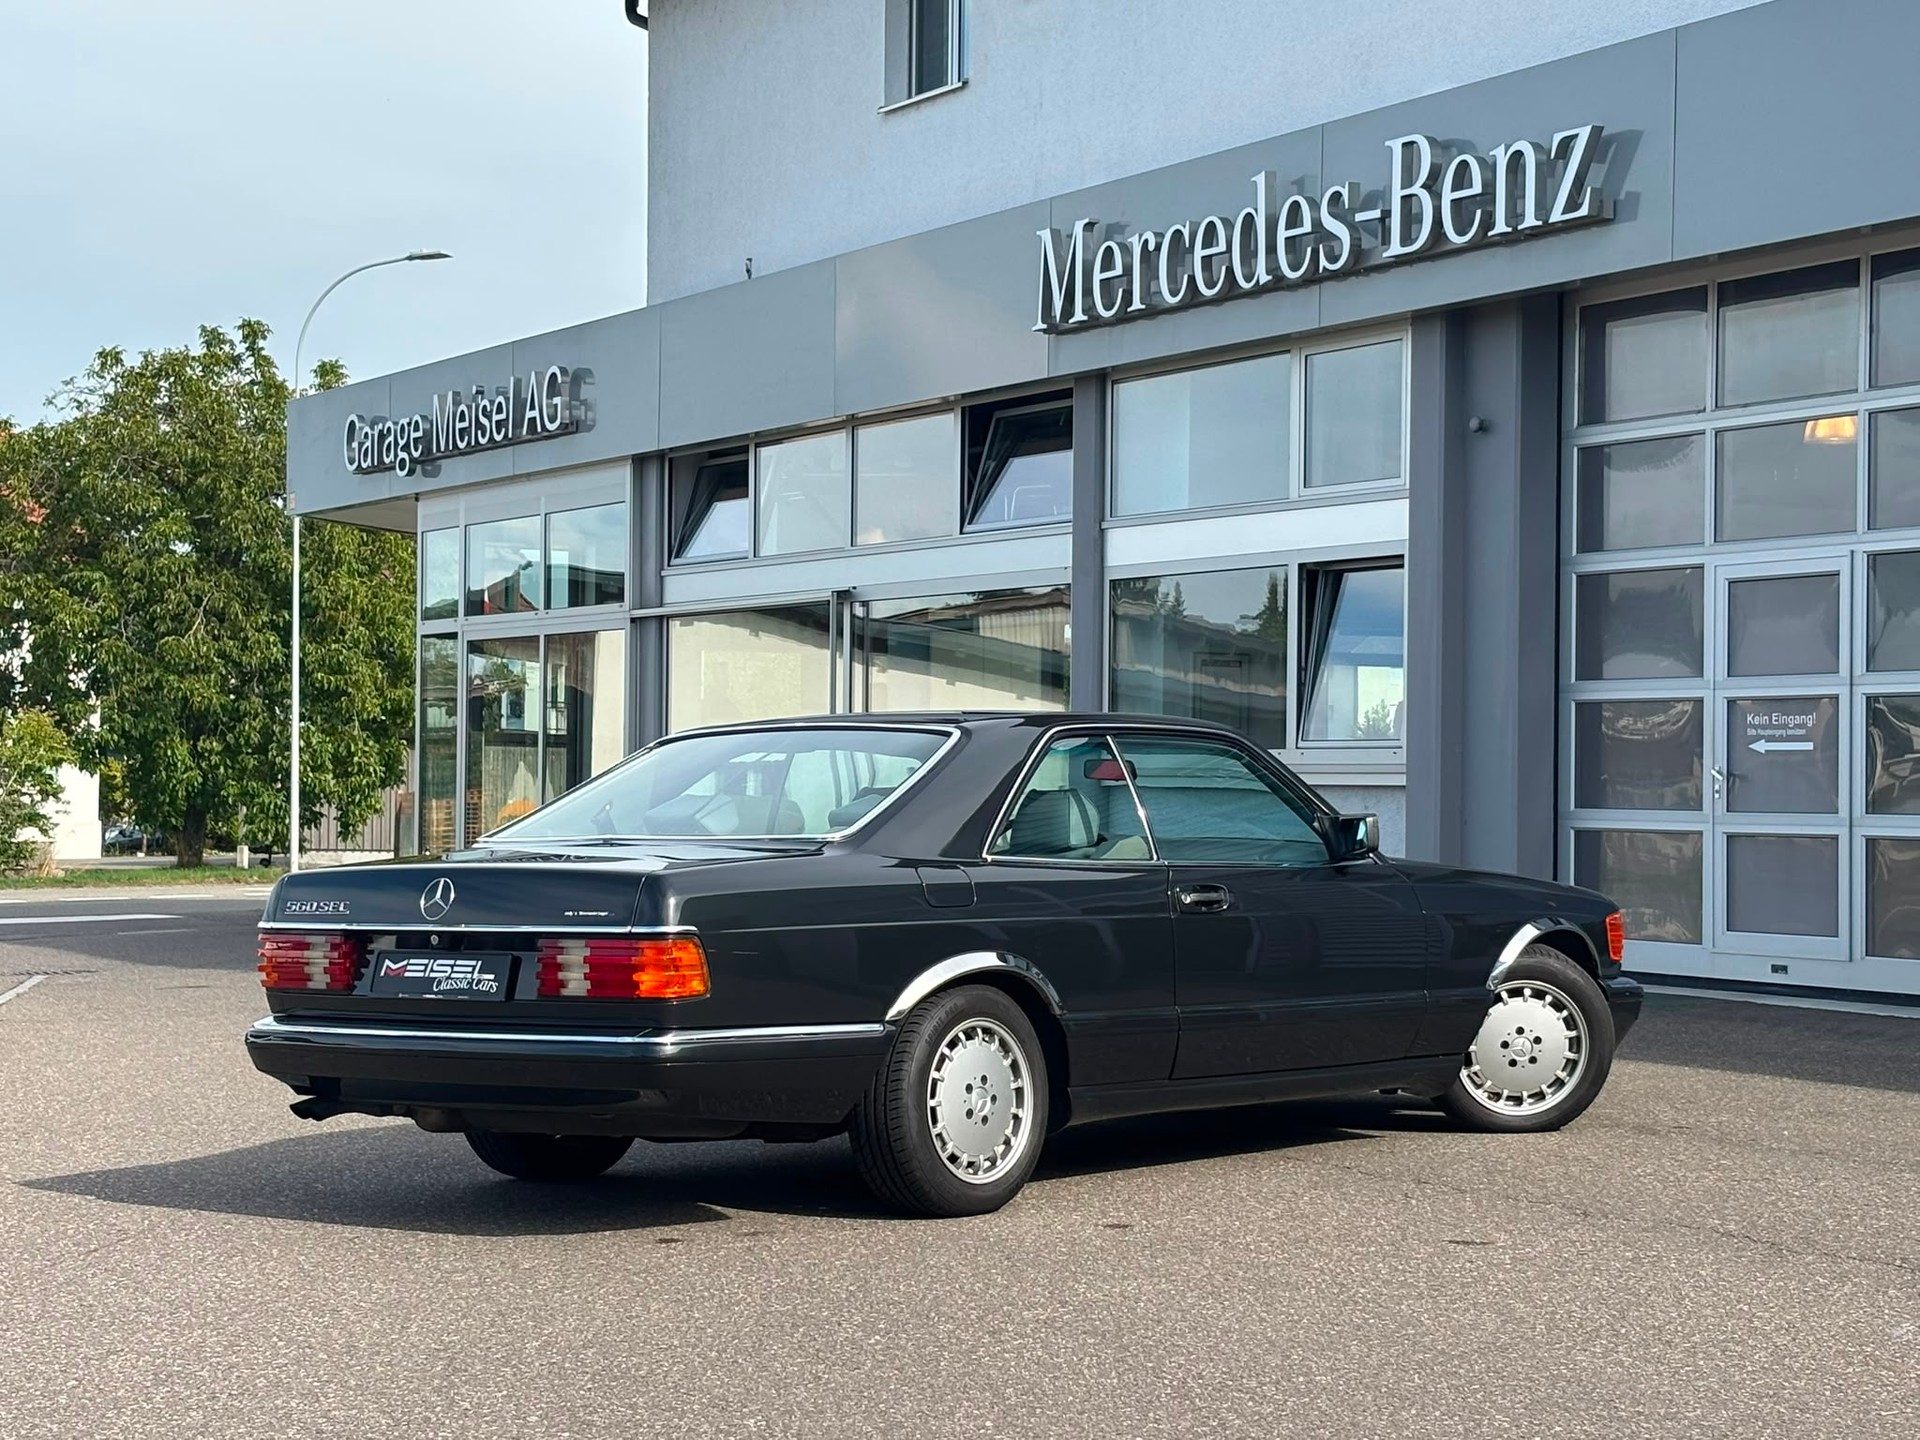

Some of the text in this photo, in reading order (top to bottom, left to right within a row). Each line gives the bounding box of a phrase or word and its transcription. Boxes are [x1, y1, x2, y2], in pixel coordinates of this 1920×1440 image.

[1033, 124, 1604, 333] Mercedes-Benz
[344, 365, 563, 478] Garage Meisel AG
[1746, 712, 1817, 727] Kein Eingang!
[286, 901, 350, 911] 560 SEC
[380, 958, 495, 980] MEISEL
[433, 975, 498, 993] Classic Cars
